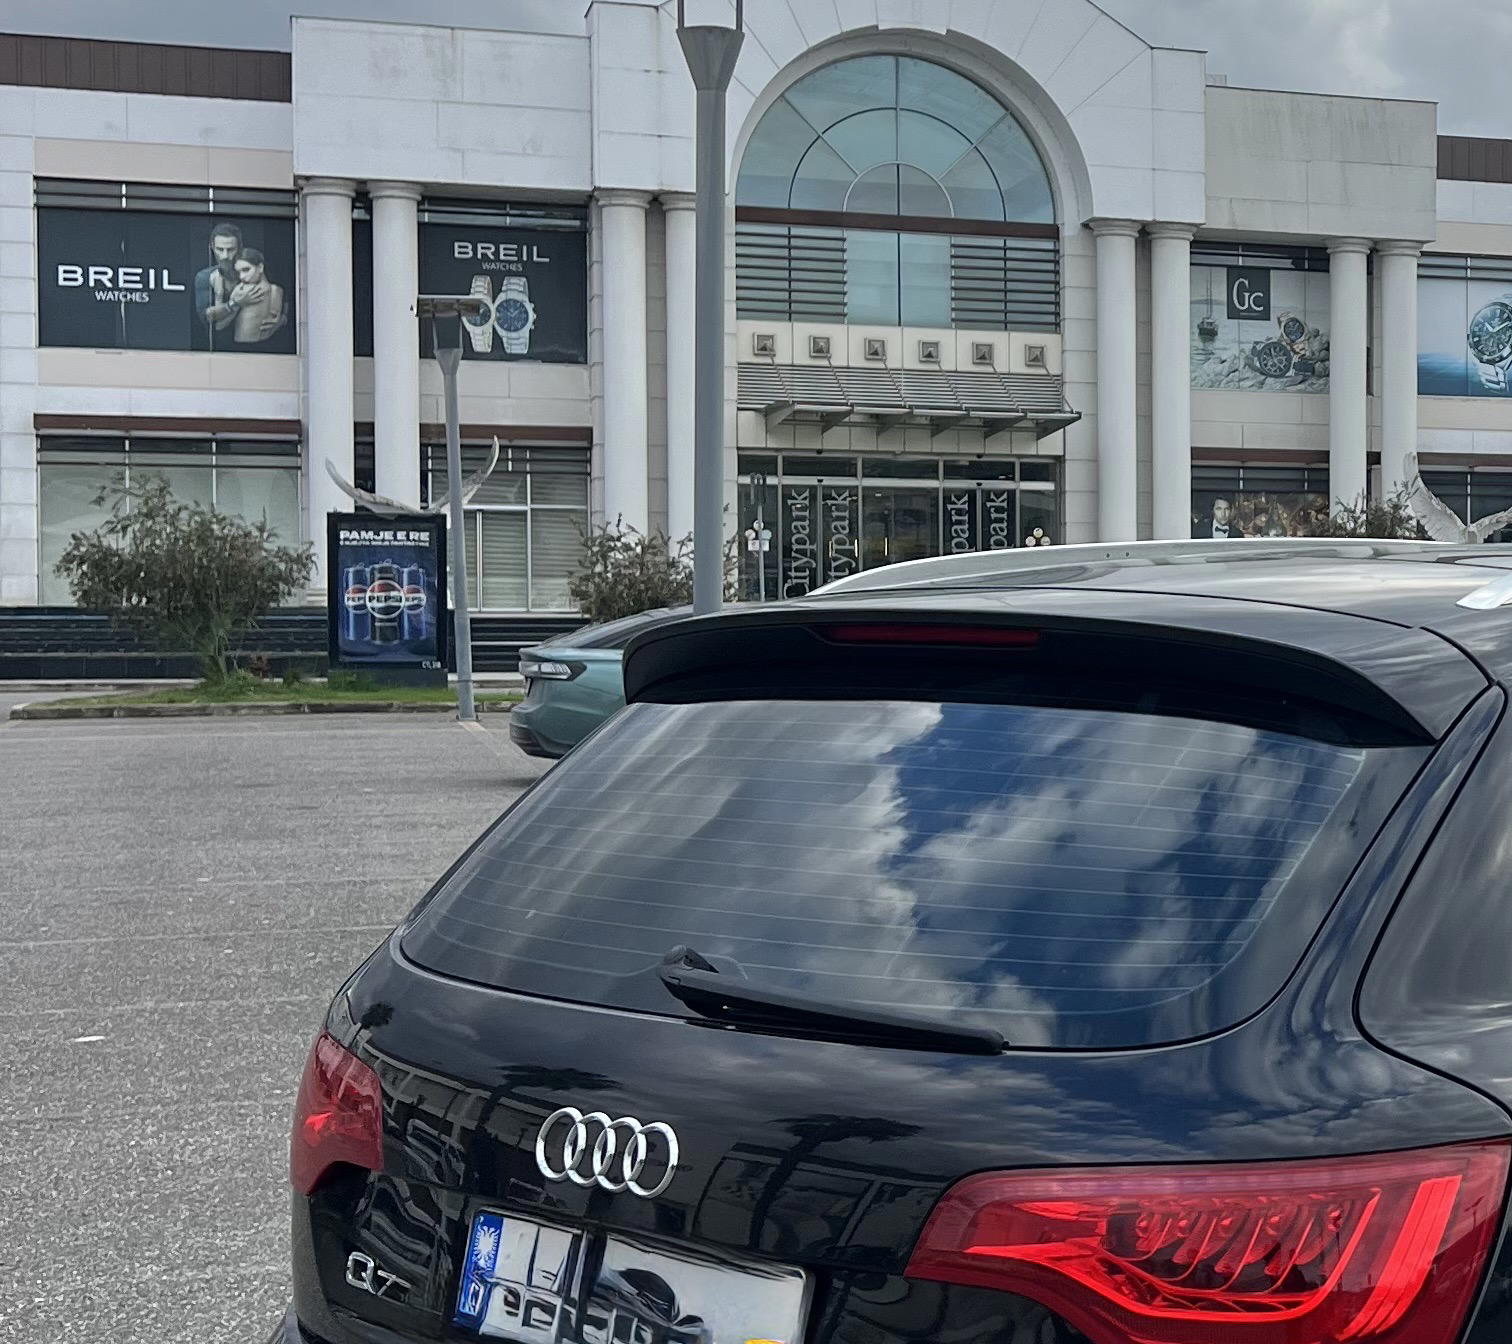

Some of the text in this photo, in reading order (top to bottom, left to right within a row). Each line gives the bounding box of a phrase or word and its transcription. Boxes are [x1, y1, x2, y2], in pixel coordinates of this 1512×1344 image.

[454, 241, 550, 262] BREIL
[482, 262, 523, 272] WATCHES
[58, 264, 185, 291] BREIL
[1232, 277, 1264, 311] Gc
[95, 290, 149, 303] WATCHES
[946, 493, 976, 553] park
[986, 491, 1014, 550] park
[784, 488, 817, 599] Citypark
[345, 1251, 412, 1296] Q7
